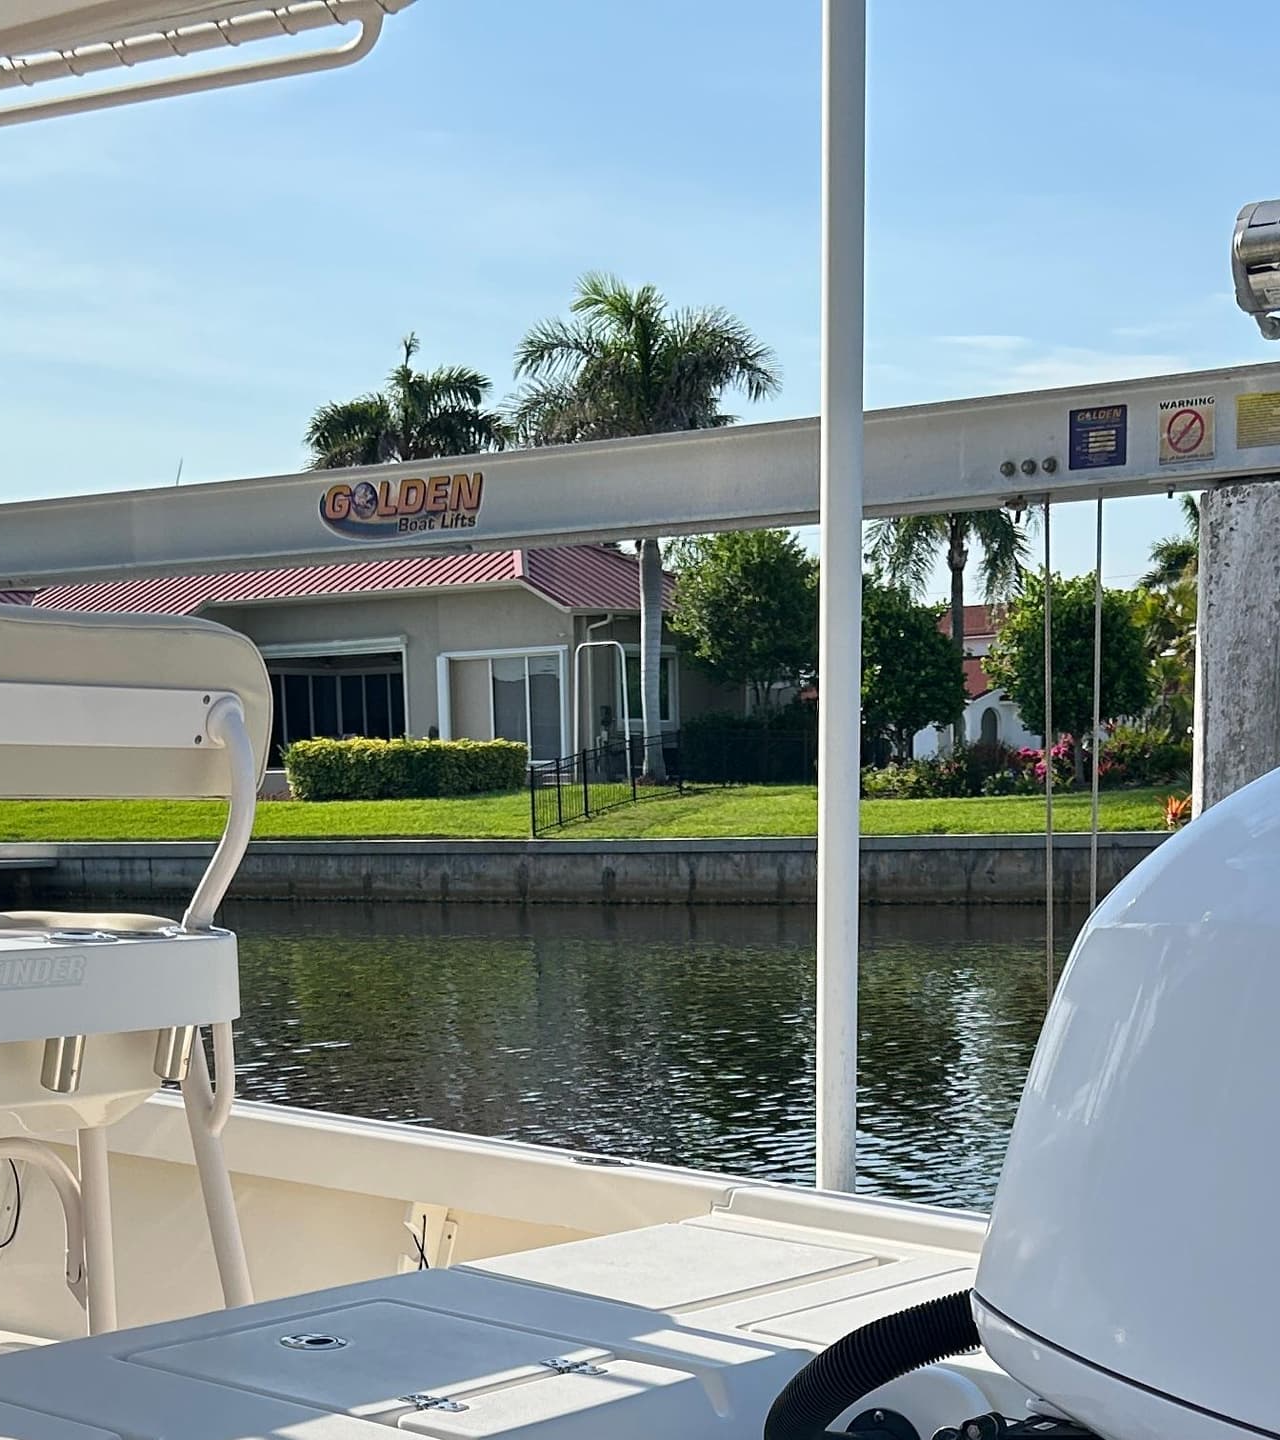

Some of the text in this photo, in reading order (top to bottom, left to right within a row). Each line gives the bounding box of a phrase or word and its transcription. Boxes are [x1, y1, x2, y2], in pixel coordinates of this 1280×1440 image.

[1159, 395, 1215, 410] WARNING
[324, 472, 484, 521] GOLDEN
[398, 513, 476, 533] Boat Lifts
